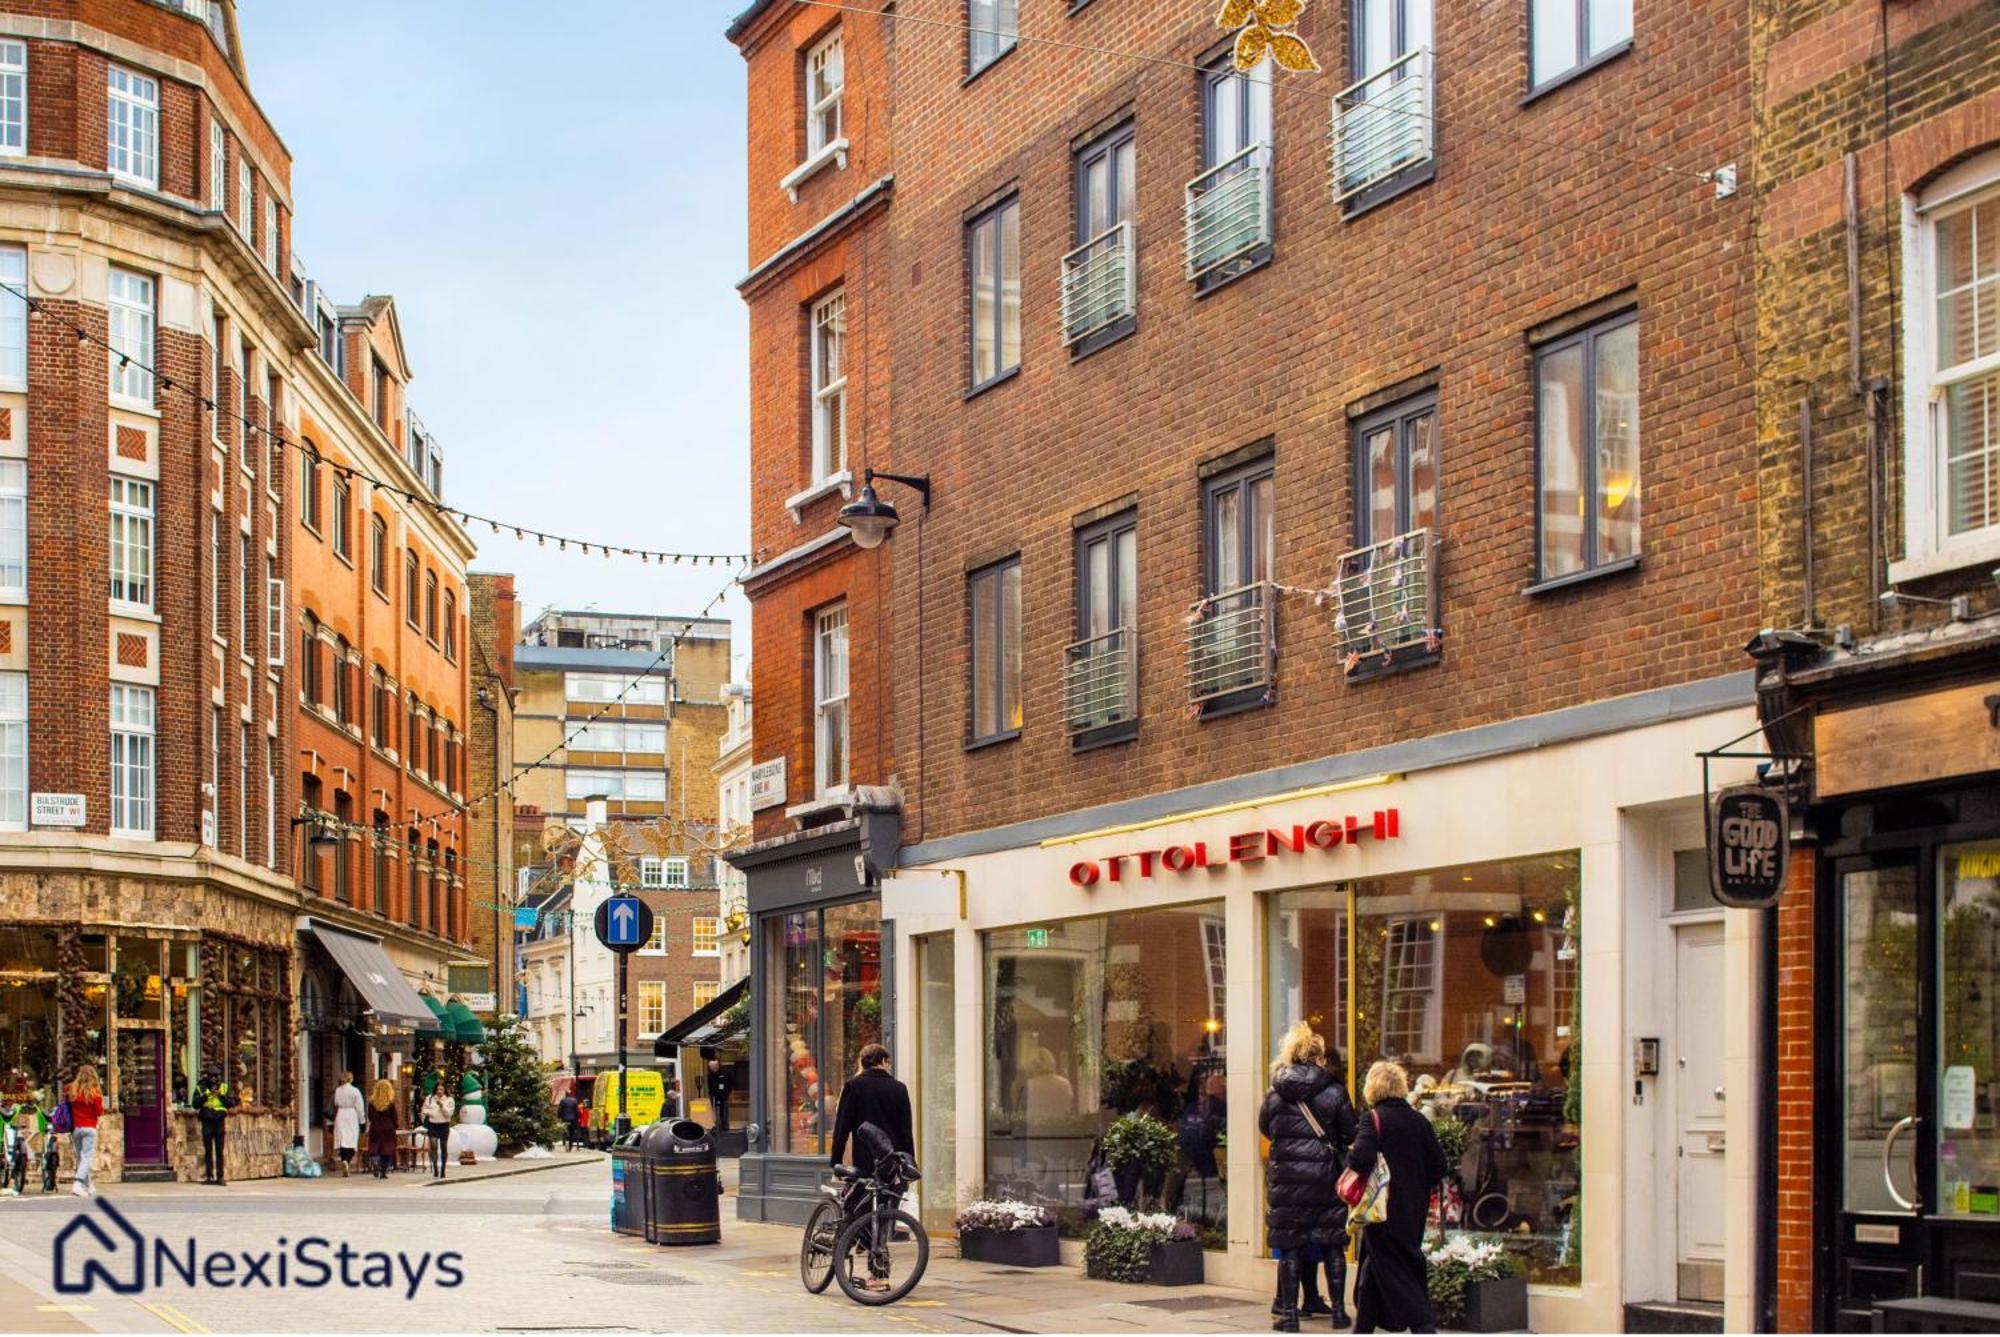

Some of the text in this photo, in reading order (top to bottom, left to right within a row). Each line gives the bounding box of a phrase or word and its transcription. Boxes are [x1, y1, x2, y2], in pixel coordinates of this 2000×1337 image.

[36, 796, 80, 806] BULSTRODE
[36, 805, 80, 815] STREET W1
[1722, 816, 1779, 849] GOOD
[1069, 808, 1399, 886] OTTOLENGHI
